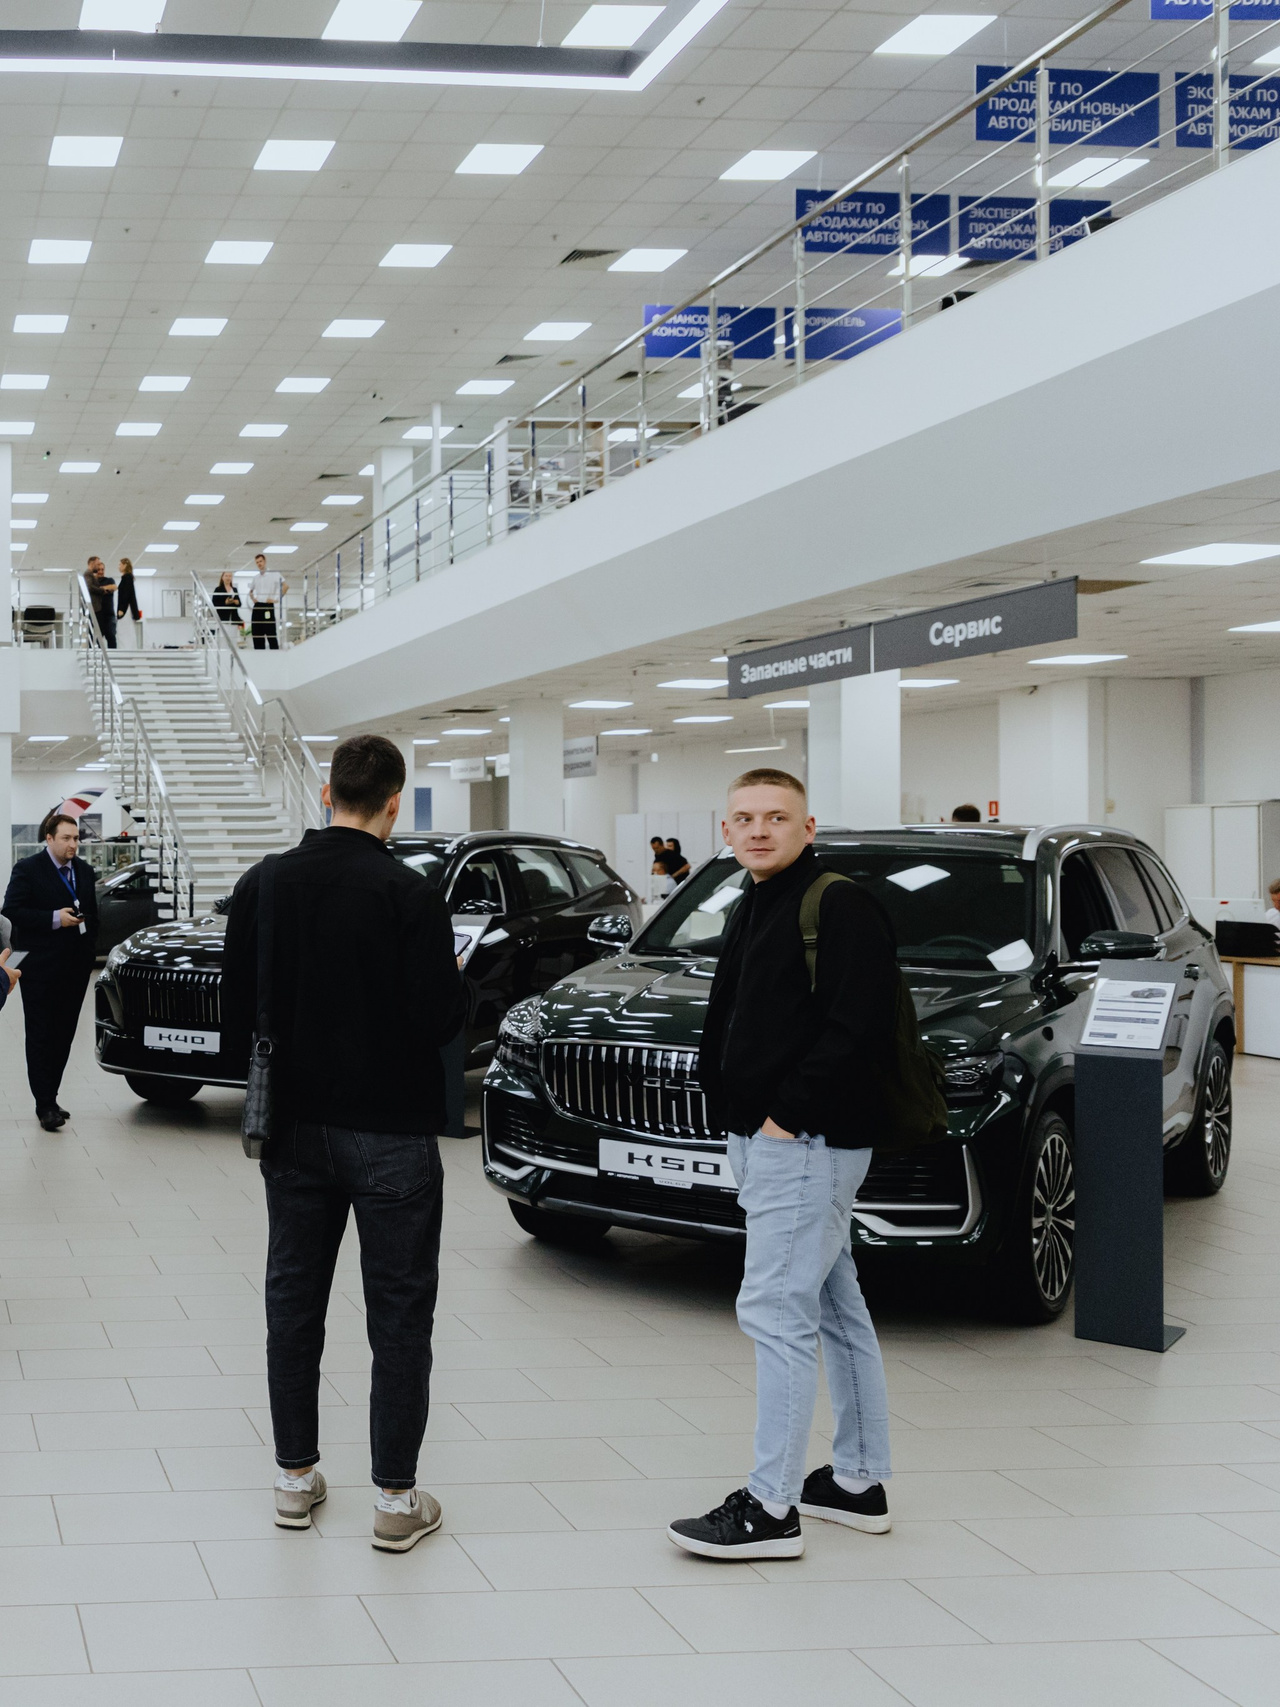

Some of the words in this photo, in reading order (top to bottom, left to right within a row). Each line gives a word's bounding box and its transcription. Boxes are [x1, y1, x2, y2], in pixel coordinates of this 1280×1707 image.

[1060, 82, 1083, 96] ПО
[1187, 86, 1252, 101] ЭКСЕРТ
[1257, 89, 1279, 102] ПО
[1080, 101, 1135, 116] НОВЫХ
[1188, 104, 1271, 120] ПРАЖАМ
[988, 116, 1103, 134] АВТОМБИЛЕЙ
[805, 200, 863, 213] ЭПЕРТ
[865, 202, 886, 214] ПО
[883, 218, 930, 231] НОЫХ
[969, 237, 1064, 251] АВТОМОБИЕЙ
[651, 326, 732, 338] КОНСУЛЬТНТ
[928, 615, 1003, 648] Сервис
[740, 654, 808, 684] Запасные
[809, 646, 853, 671] части
[158, 1032, 205, 1045] K40
[627, 1151, 721, 1176] K50
